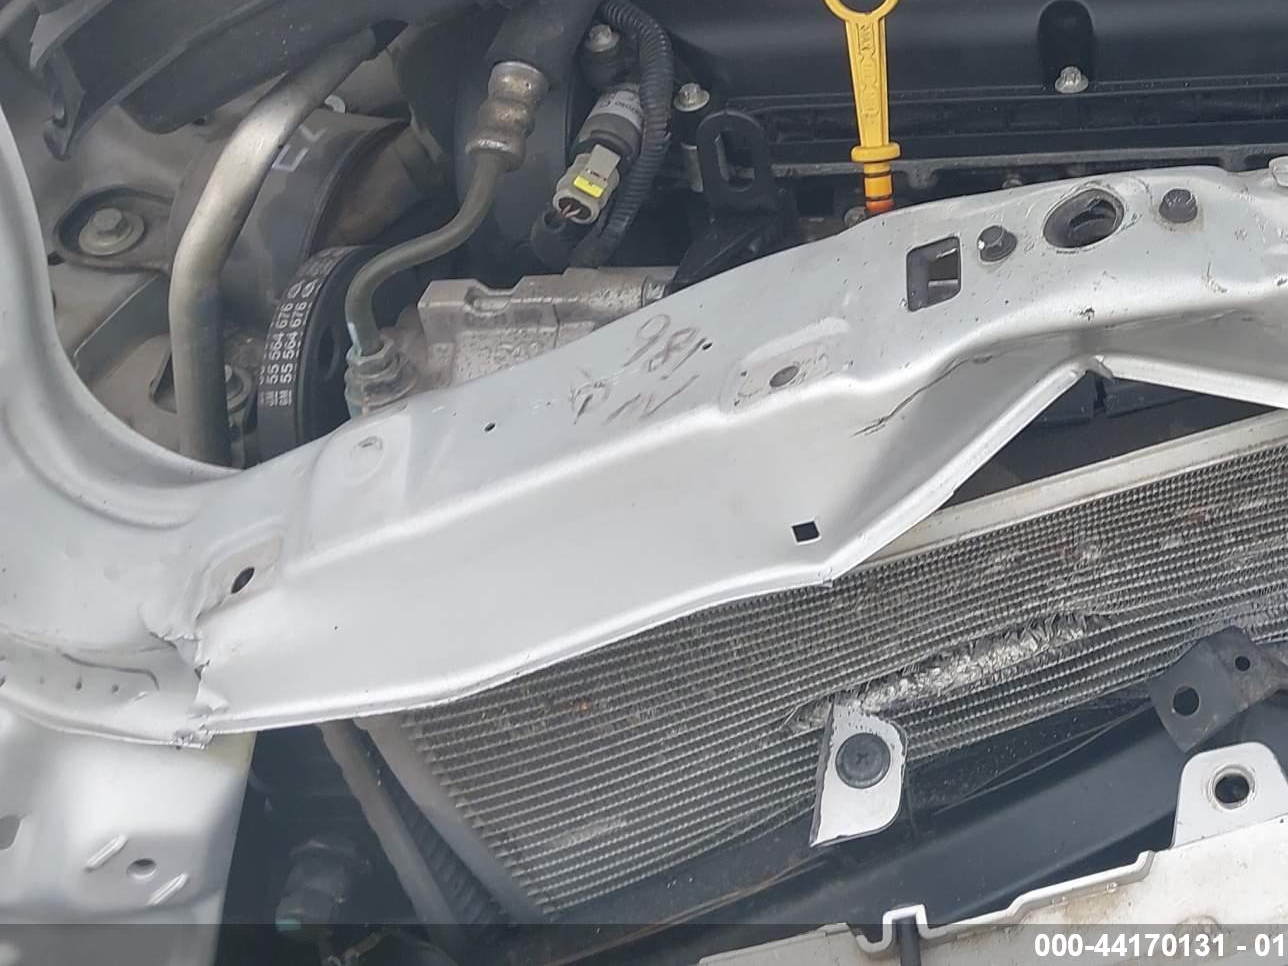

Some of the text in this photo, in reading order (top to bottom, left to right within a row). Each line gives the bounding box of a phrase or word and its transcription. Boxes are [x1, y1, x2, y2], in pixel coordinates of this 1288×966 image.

[289, 301, 308, 329] 676
[283, 331, 299, 361] 564
[280, 362, 294, 384] 55
